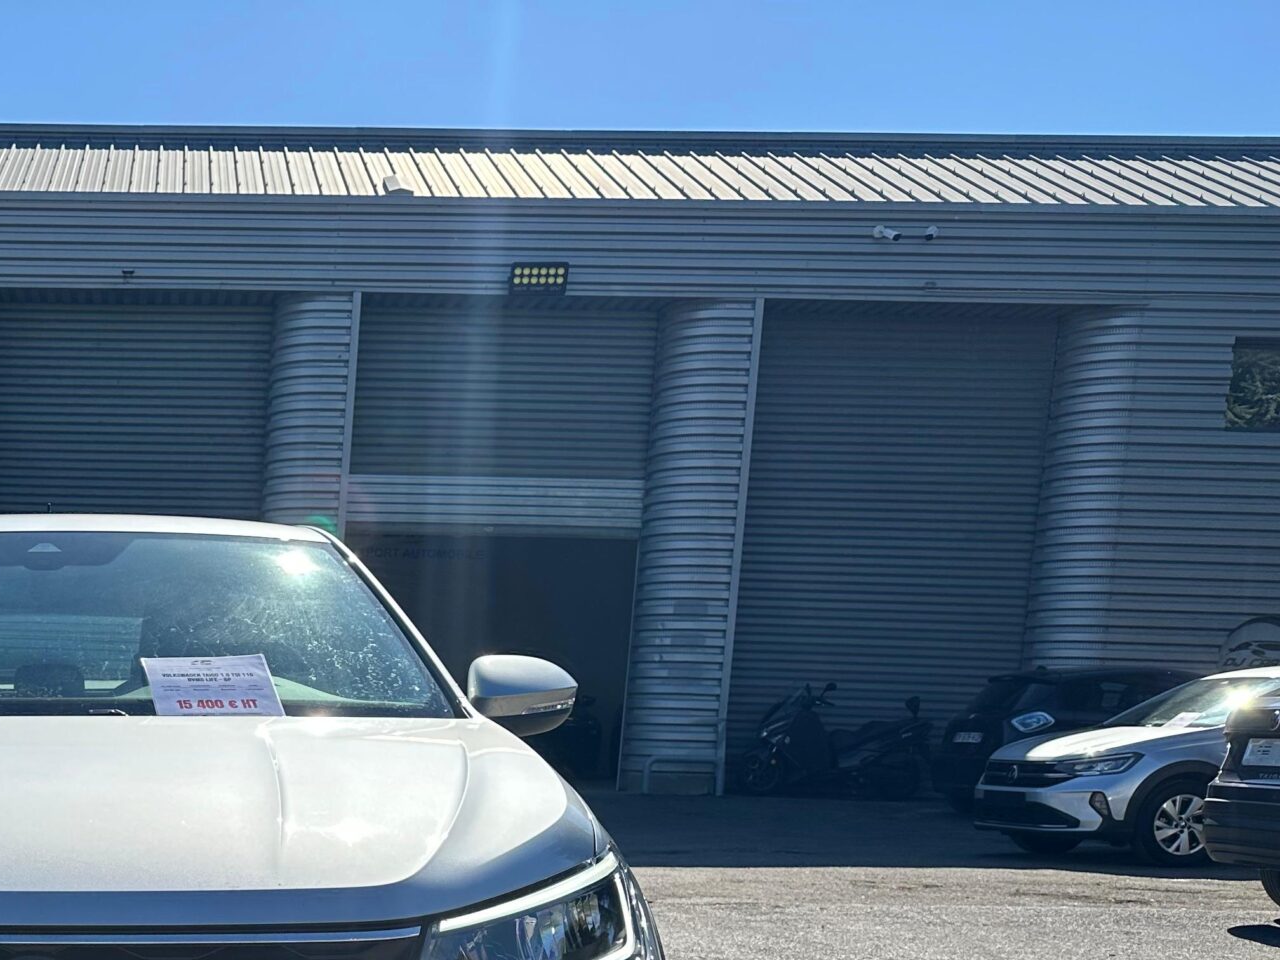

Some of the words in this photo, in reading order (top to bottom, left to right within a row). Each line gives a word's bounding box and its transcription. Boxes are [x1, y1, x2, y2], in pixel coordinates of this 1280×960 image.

[176, 699, 193, 709] 15
[196, 699, 225, 709] 400
[228, 699, 238, 709] €
[240, 698, 258, 709] HT
